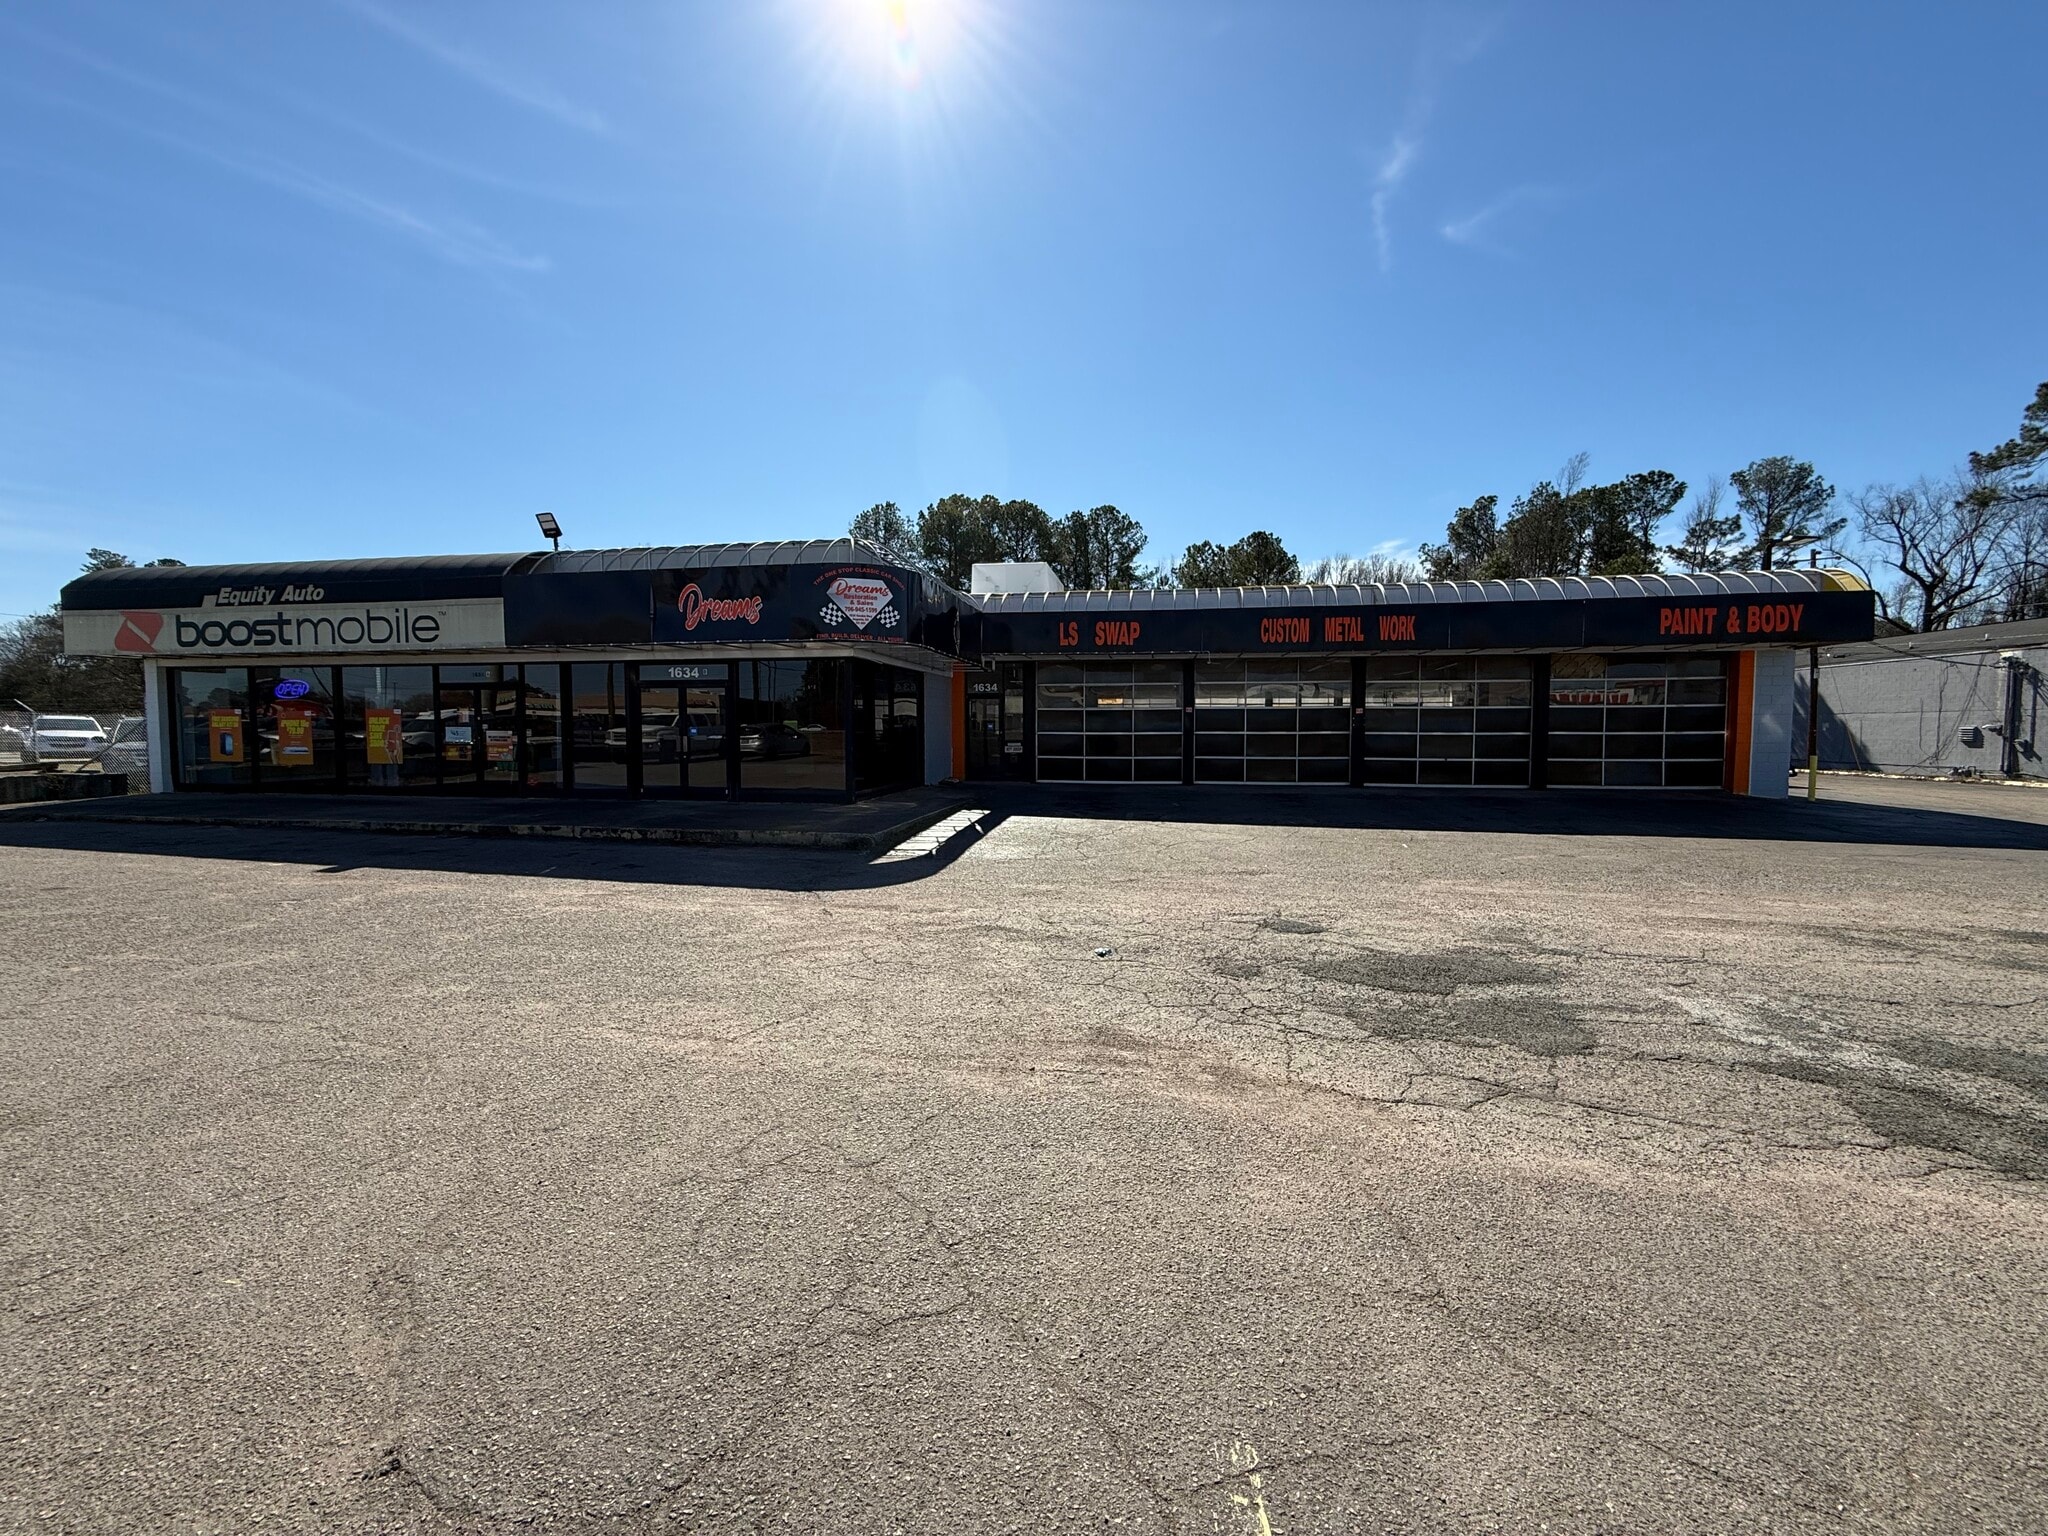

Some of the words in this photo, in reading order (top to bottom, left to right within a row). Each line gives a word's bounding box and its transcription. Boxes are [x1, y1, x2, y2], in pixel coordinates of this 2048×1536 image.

[814, 575, 824, 586] THE
[825, 570, 836, 578] ONE
[855, 567, 880, 575] CLASSIC
[880, 571, 892, 579] CAR
[218, 586, 276, 606] Equity
[280, 584, 325, 602] Auto
[830, 579, 889, 597] Dreams
[843, 593, 878, 601] Restoration
[678, 583, 763, 631] Dreams
[1260, 618, 1310, 643] CUSTOM
[1324, 617, 1364, 642] METAL
[1378, 615, 1416, 641] WORK
[1659, 607, 1718, 635] PAINT
[1726, 606, 1741, 633] &
[1746, 604, 1804, 633] BODY
[1059, 621, 1079, 646] LS
[1094, 621, 1141, 646] SWAP
[668, 667, 699, 678] 1634
[278, 683, 306, 695] OPEN
[973, 683, 998, 692] 1634
